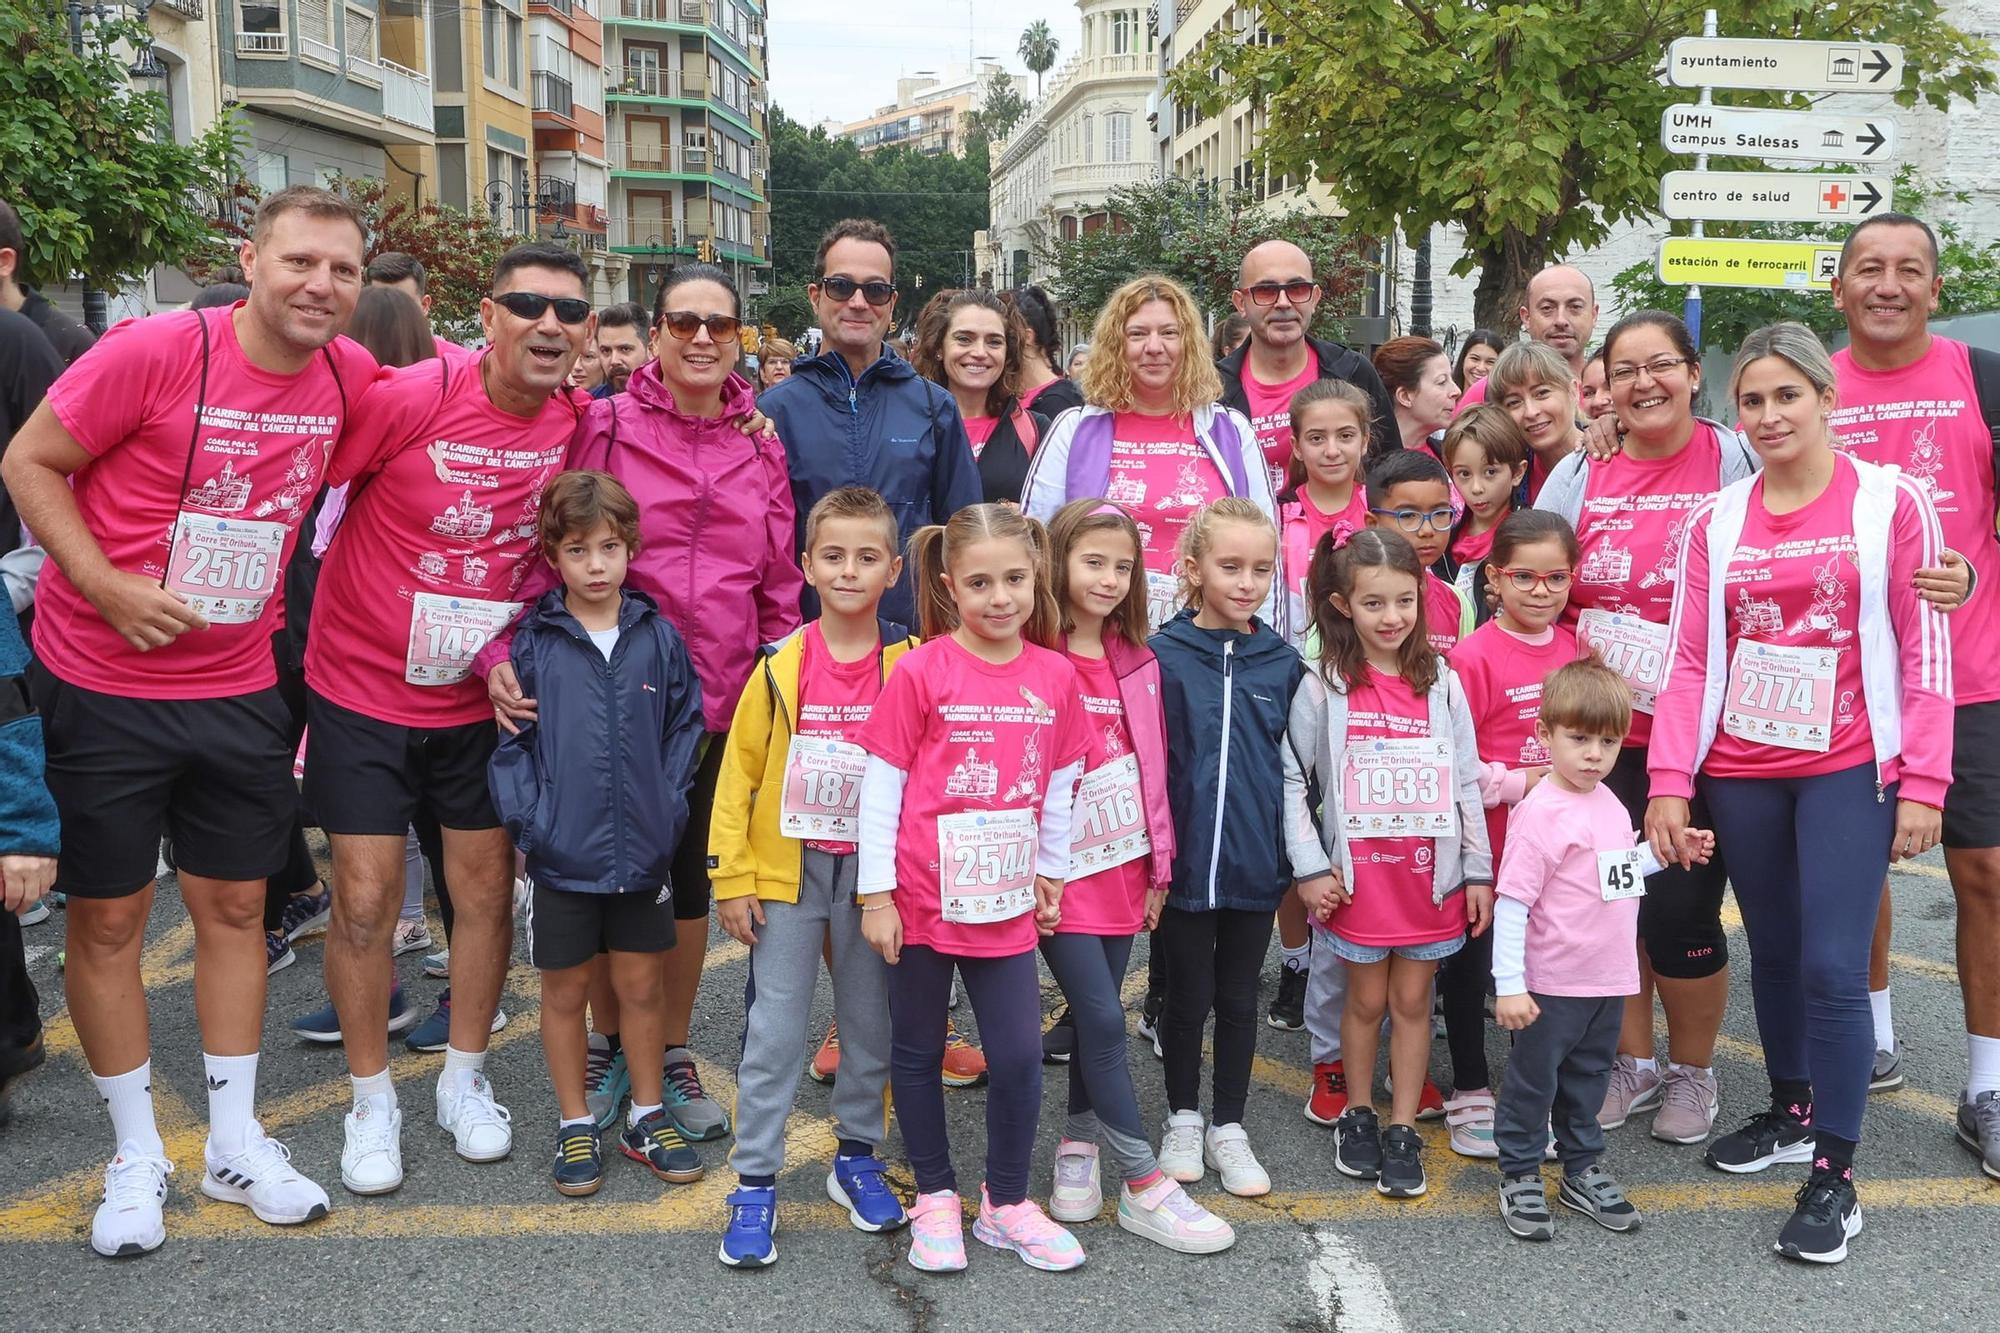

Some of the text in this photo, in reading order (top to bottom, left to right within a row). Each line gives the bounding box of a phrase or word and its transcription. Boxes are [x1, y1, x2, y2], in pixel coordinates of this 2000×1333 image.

[1680, 54, 1778, 68] ayuntamiento
[1672, 113, 1712, 128] UMH
[1671, 133, 1799, 149] campus Salesas
[1672, 190, 1790, 202] centro de salud
[1668, 254, 1807, 271] estación de ferrocarril
[1868, 405, 1875, 413] Y
[1875, 401, 1914, 412] MARCHA
[1916, 400, 1936, 409] POR
[1937, 400, 1948, 409] EL
[1949, 399, 1965, 409] DÍA
[208, 406, 252, 421] CARRERA
[254, 413, 260, 421] Y
[260, 413, 297, 424] MARCHA
[299, 416, 316, 425] POR
[318, 416, 327, 425] EL
[1859, 413, 1875, 423] DEL
[1877, 408, 1913, 420] CÁNCER
[1913, 408, 1925, 417] DE
[1926, 408, 1958, 417] MAMA
[200, 415, 241, 430] MUNDIAL
[243, 421, 260, 432] DEL
[261, 422, 295, 434] CÁNCER
[296, 425, 309, 434] DE
[207, 437, 246, 448] CORRE POR
[449, 442, 493, 457] CARRERA
[496, 449, 503, 458] Y
[504, 450, 538, 460] MARCHA
[486, 457, 502, 467] DEL
[1630, 495, 1637, 503] Y
[1674, 493, 1692, 501] POR
[1619, 503, 1635, 511] DEL
[1670, 501, 1681, 509] DE
[195, 533, 218, 545] Corre
[229, 538, 257, 549] Orihuela
[1775, 535, 1852, 551] MARCHA POR EL
[1775, 546, 1827, 559] CÁNCER DE
[180, 545, 268, 591] 2516
[431, 612, 452, 622] Corre
[463, 616, 492, 626] Orihuela
[1594, 625, 1612, 635] Corre
[1622, 631, 1651, 645] Orihuela
[1744, 658, 1760, 668] Corre
[1769, 662, 1801, 674] Orihuela
[1739, 669, 1815, 715] 2774
[836, 705, 842, 713] Y
[949, 705, 985, 714] CARRERA
[993, 706, 1024, 714] MARCHA
[828, 713, 842, 721] DEL
[944, 713, 979, 722] MUNDIAL
[980, 714, 993, 722] DEL
[1024, 715, 1034, 723] DE
[1413, 718, 1428, 727] POR
[1373, 720, 1419, 734] DEL DE
[806, 756, 828, 767] Corre
[1358, 756, 1378, 765] Corre
[1390, 756, 1421, 765] Orihuela
[1088, 783, 1117, 798] Orihuela
[1353, 767, 1440, 805] 1933
[960, 833, 980, 842] Corre
[993, 830, 1021, 839] Orihuela
[953, 840, 1032, 887] 2544
[1607, 863, 1634, 890] 45
